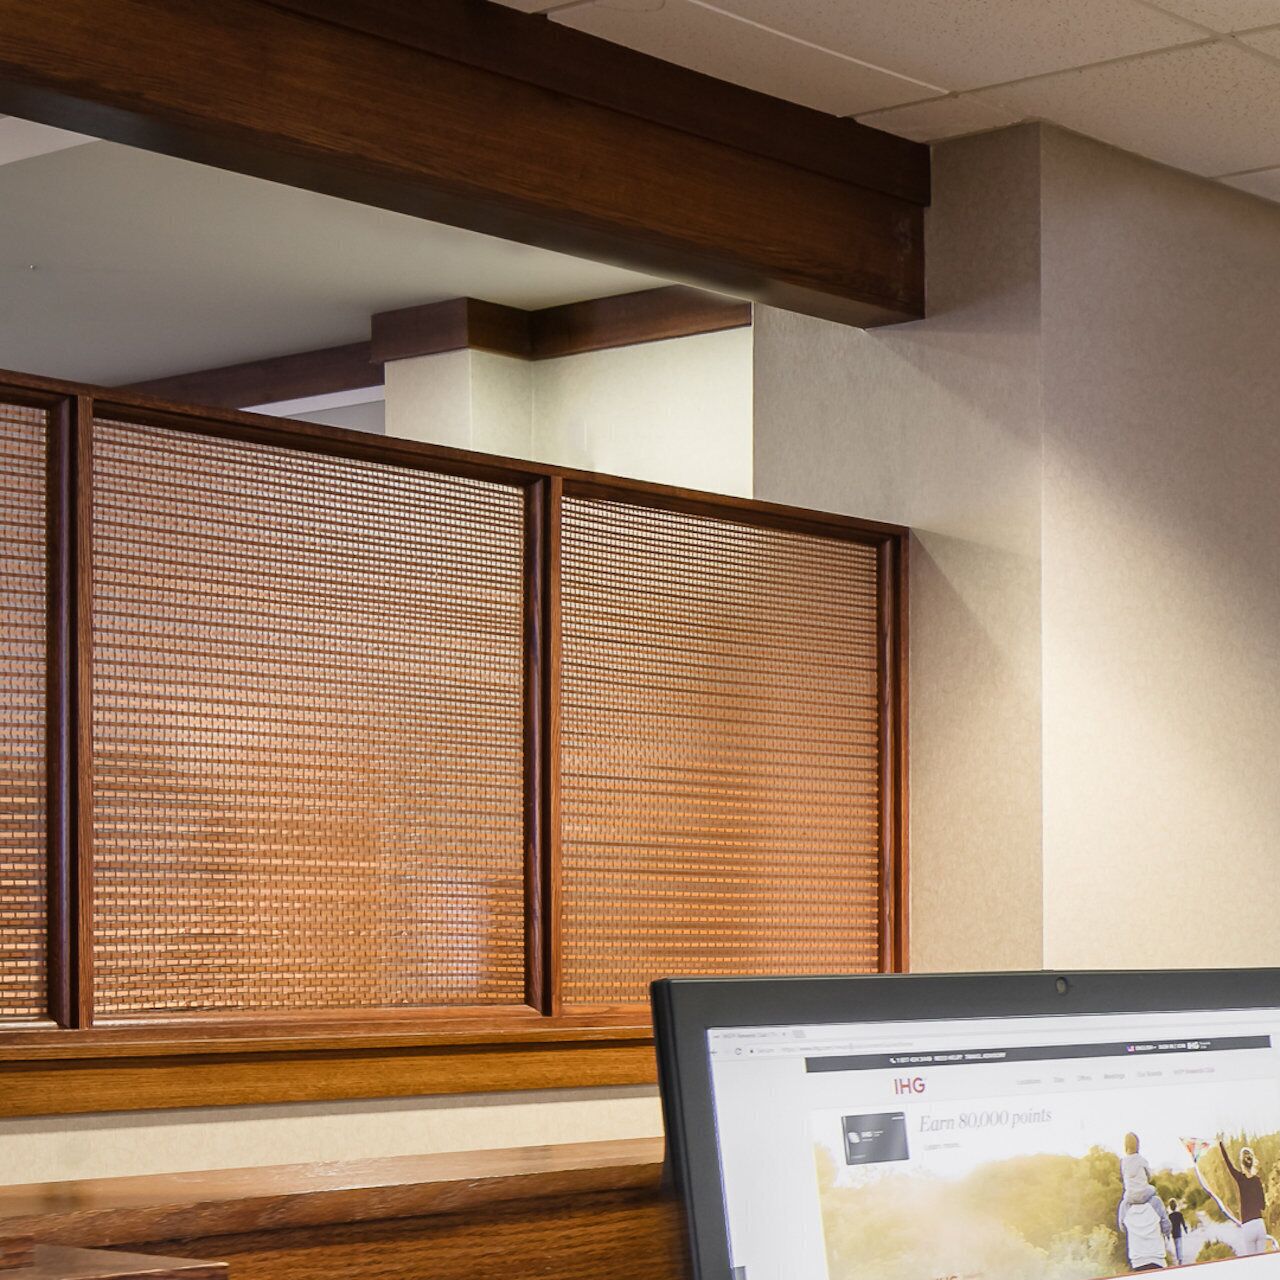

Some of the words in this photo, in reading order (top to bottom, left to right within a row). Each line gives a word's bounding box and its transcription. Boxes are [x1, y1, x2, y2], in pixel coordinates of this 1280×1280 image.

[894, 1077, 926, 1095] IHG
[920, 1115, 955, 1133] Earn
[958, 1110, 1009, 1131] 80,000
[1012, 1107, 1053, 1129] points
